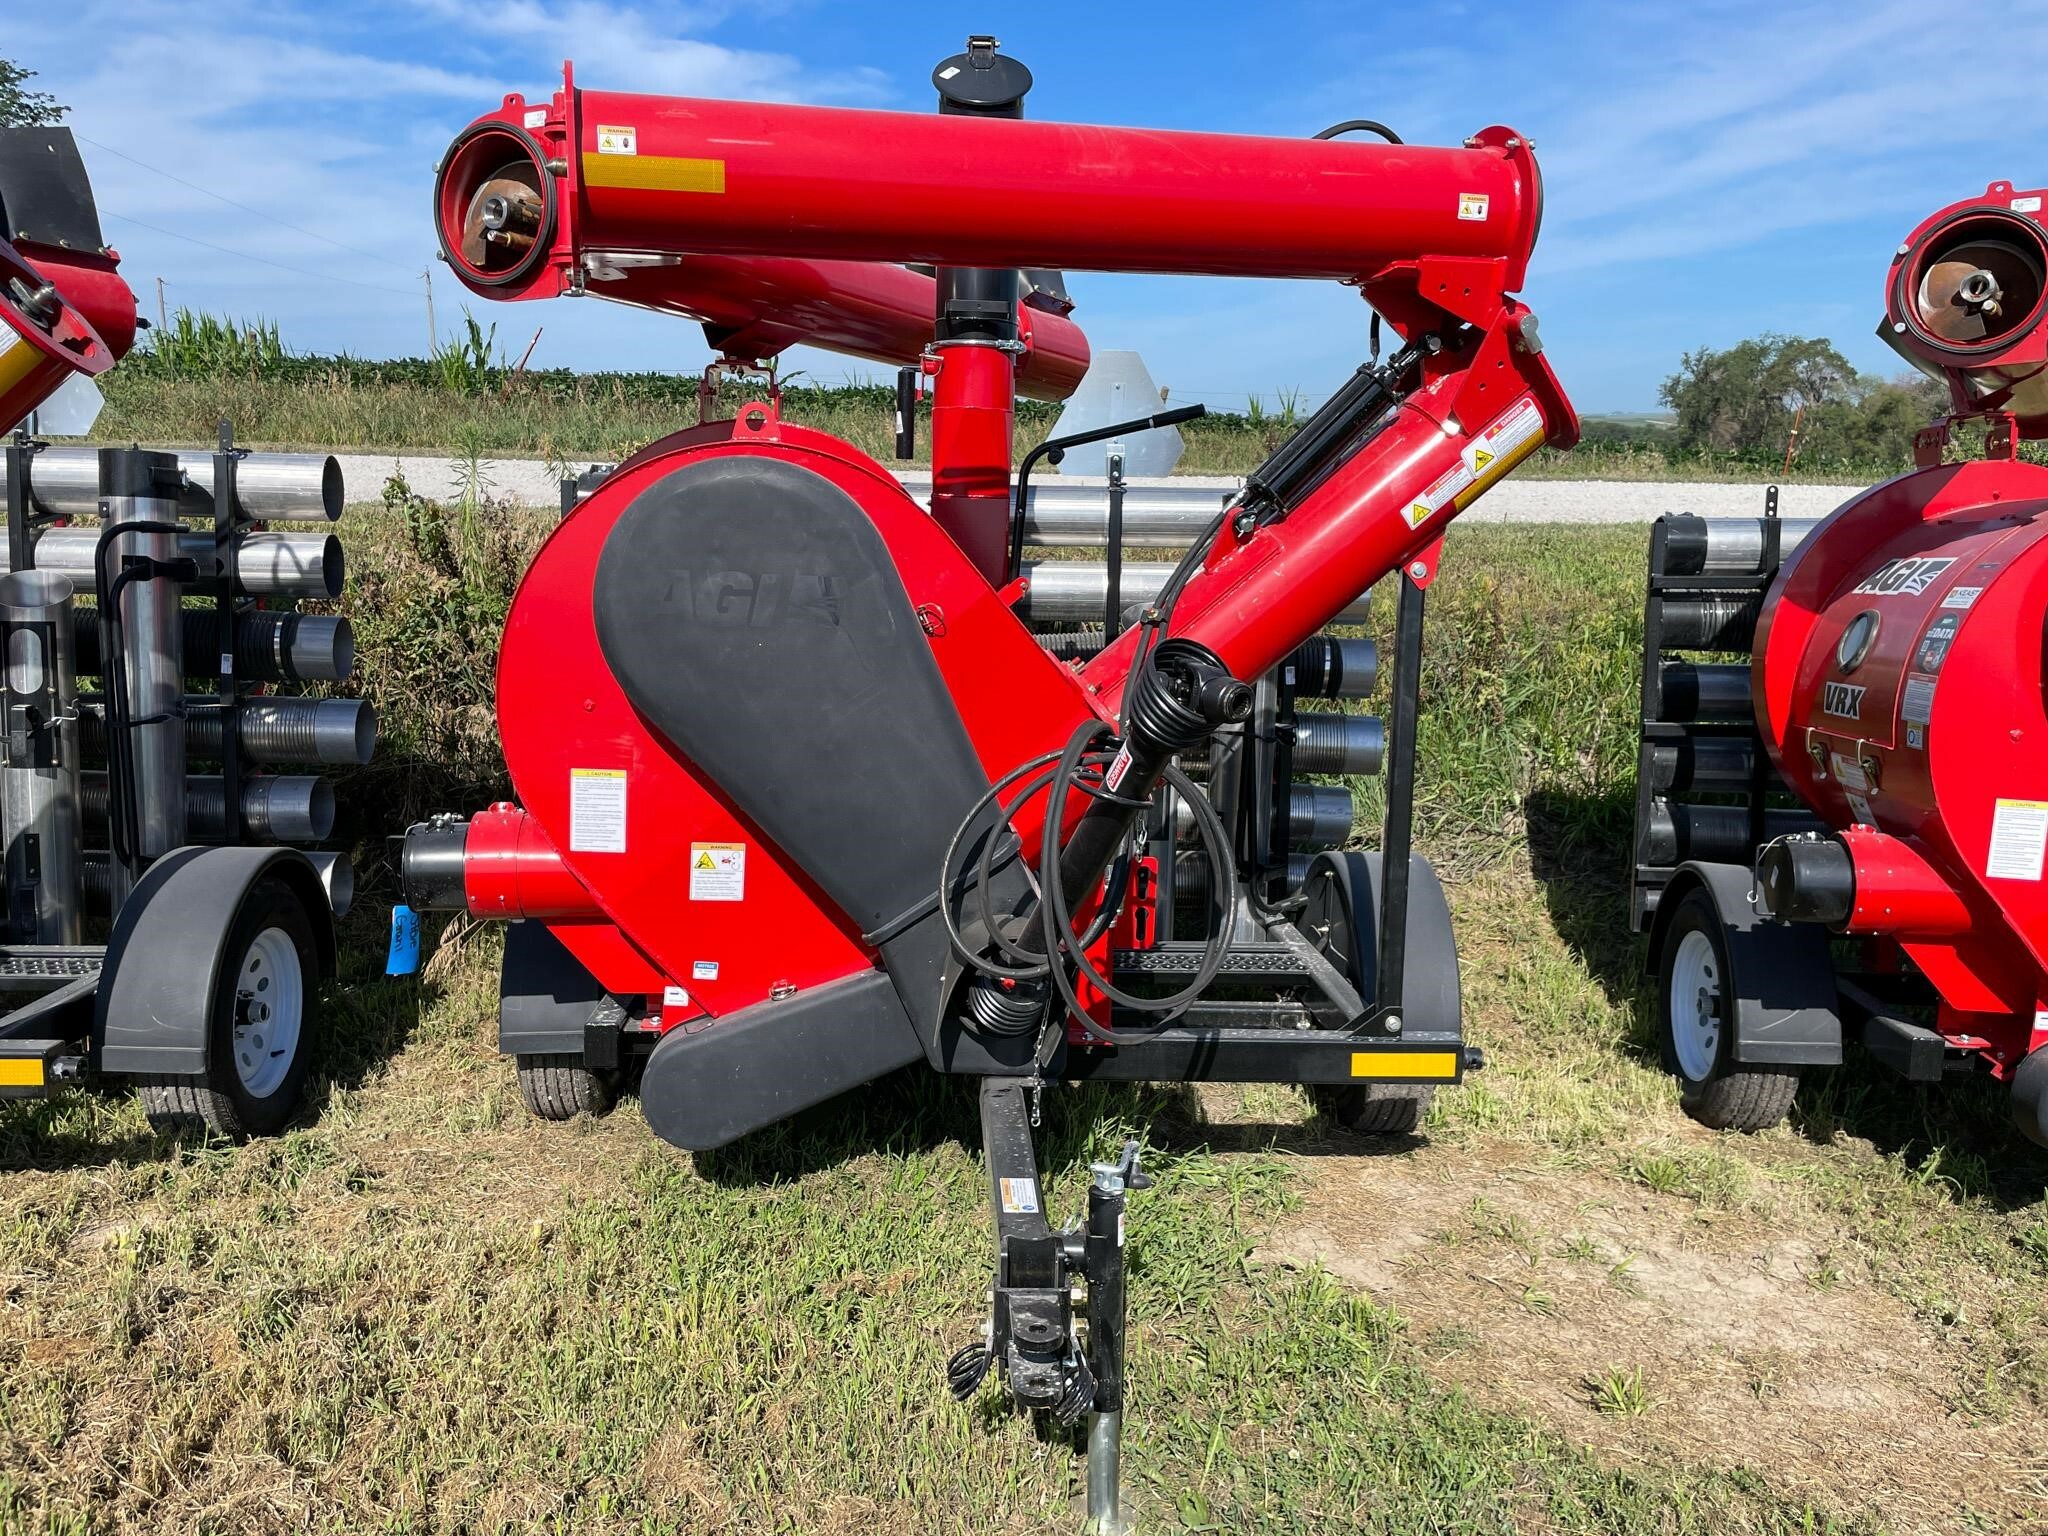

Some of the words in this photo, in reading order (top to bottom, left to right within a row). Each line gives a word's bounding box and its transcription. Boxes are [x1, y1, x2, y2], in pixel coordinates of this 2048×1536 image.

[1500, 405, 1525, 426] DANGER
[1854, 558, 1931, 594] AGI
[1825, 684, 1862, 717] VRX
